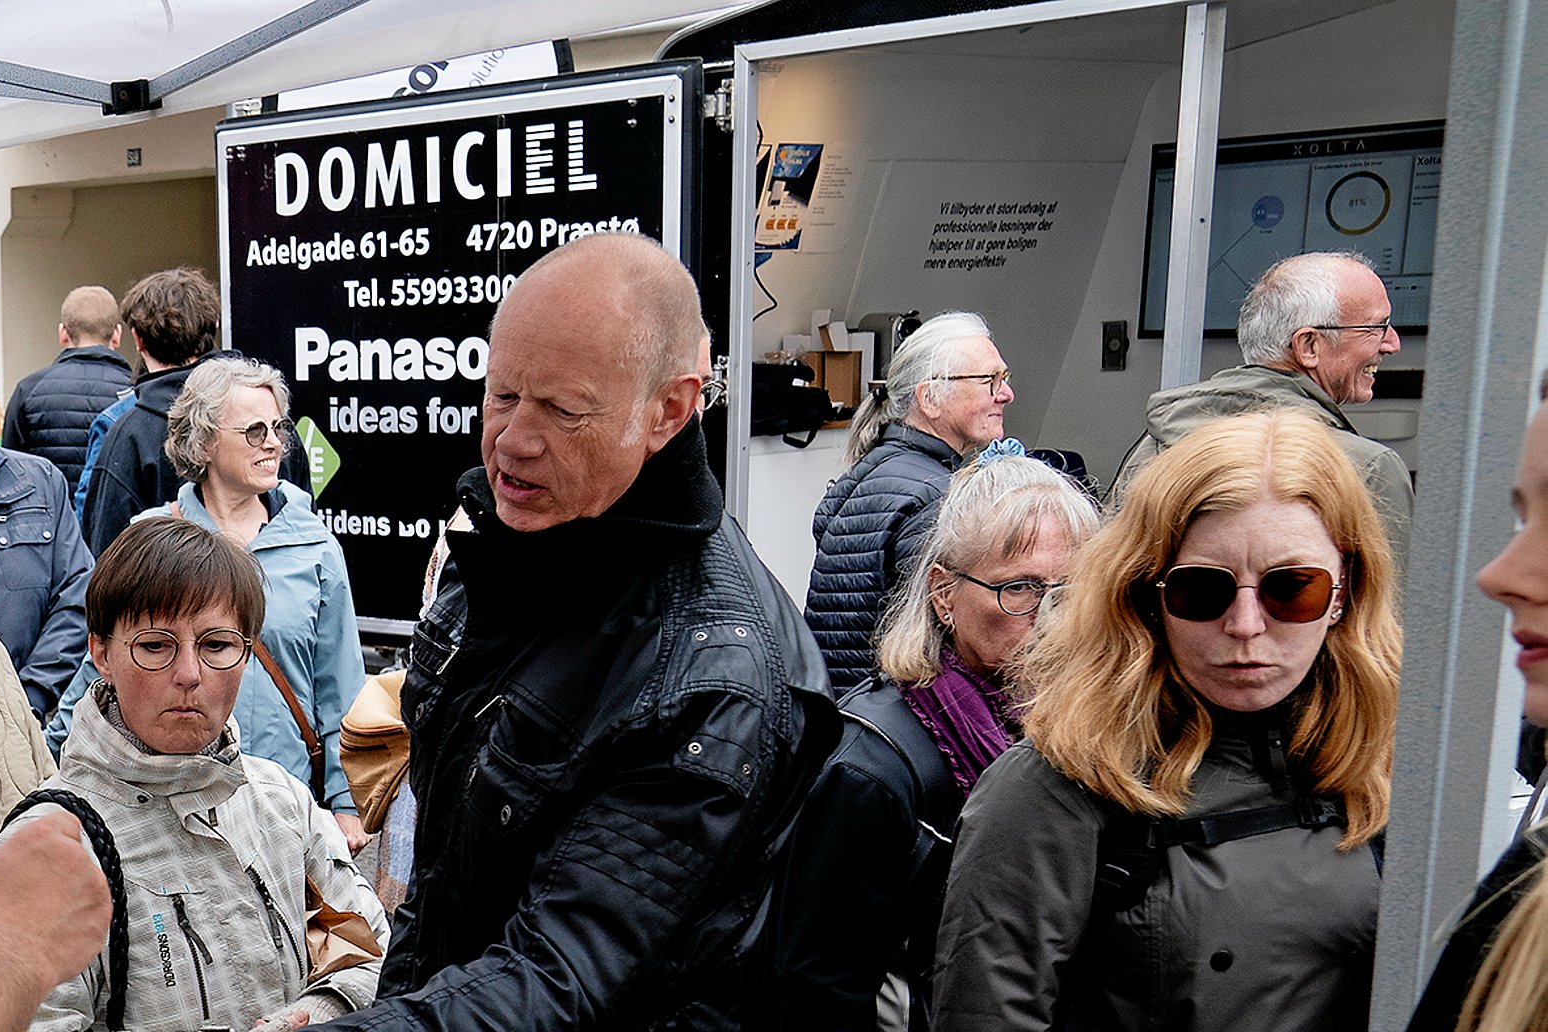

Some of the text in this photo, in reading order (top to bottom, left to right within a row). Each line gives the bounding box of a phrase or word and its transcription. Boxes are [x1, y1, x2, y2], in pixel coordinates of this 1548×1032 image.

[1293, 139, 1366, 155] XOLTA
[275, 120, 598, 217] DOMICIEL
[950, 202, 985, 218] tilbyder
[996, 201, 1018, 215] stort
[1018, 201, 1046, 217] udvalg
[933, 220, 997, 236] professionelle
[1037, 219, 1053, 231] der
[246, 232, 356, 271] Adelgade
[359, 227, 431, 260] 61-65
[465, 220, 534, 252] 4720
[1007, 238, 1038, 252] boligen
[923, 258, 946, 269] mere
[343, 277, 386, 308] Tel.
[329, 397, 478, 434] ideas for
